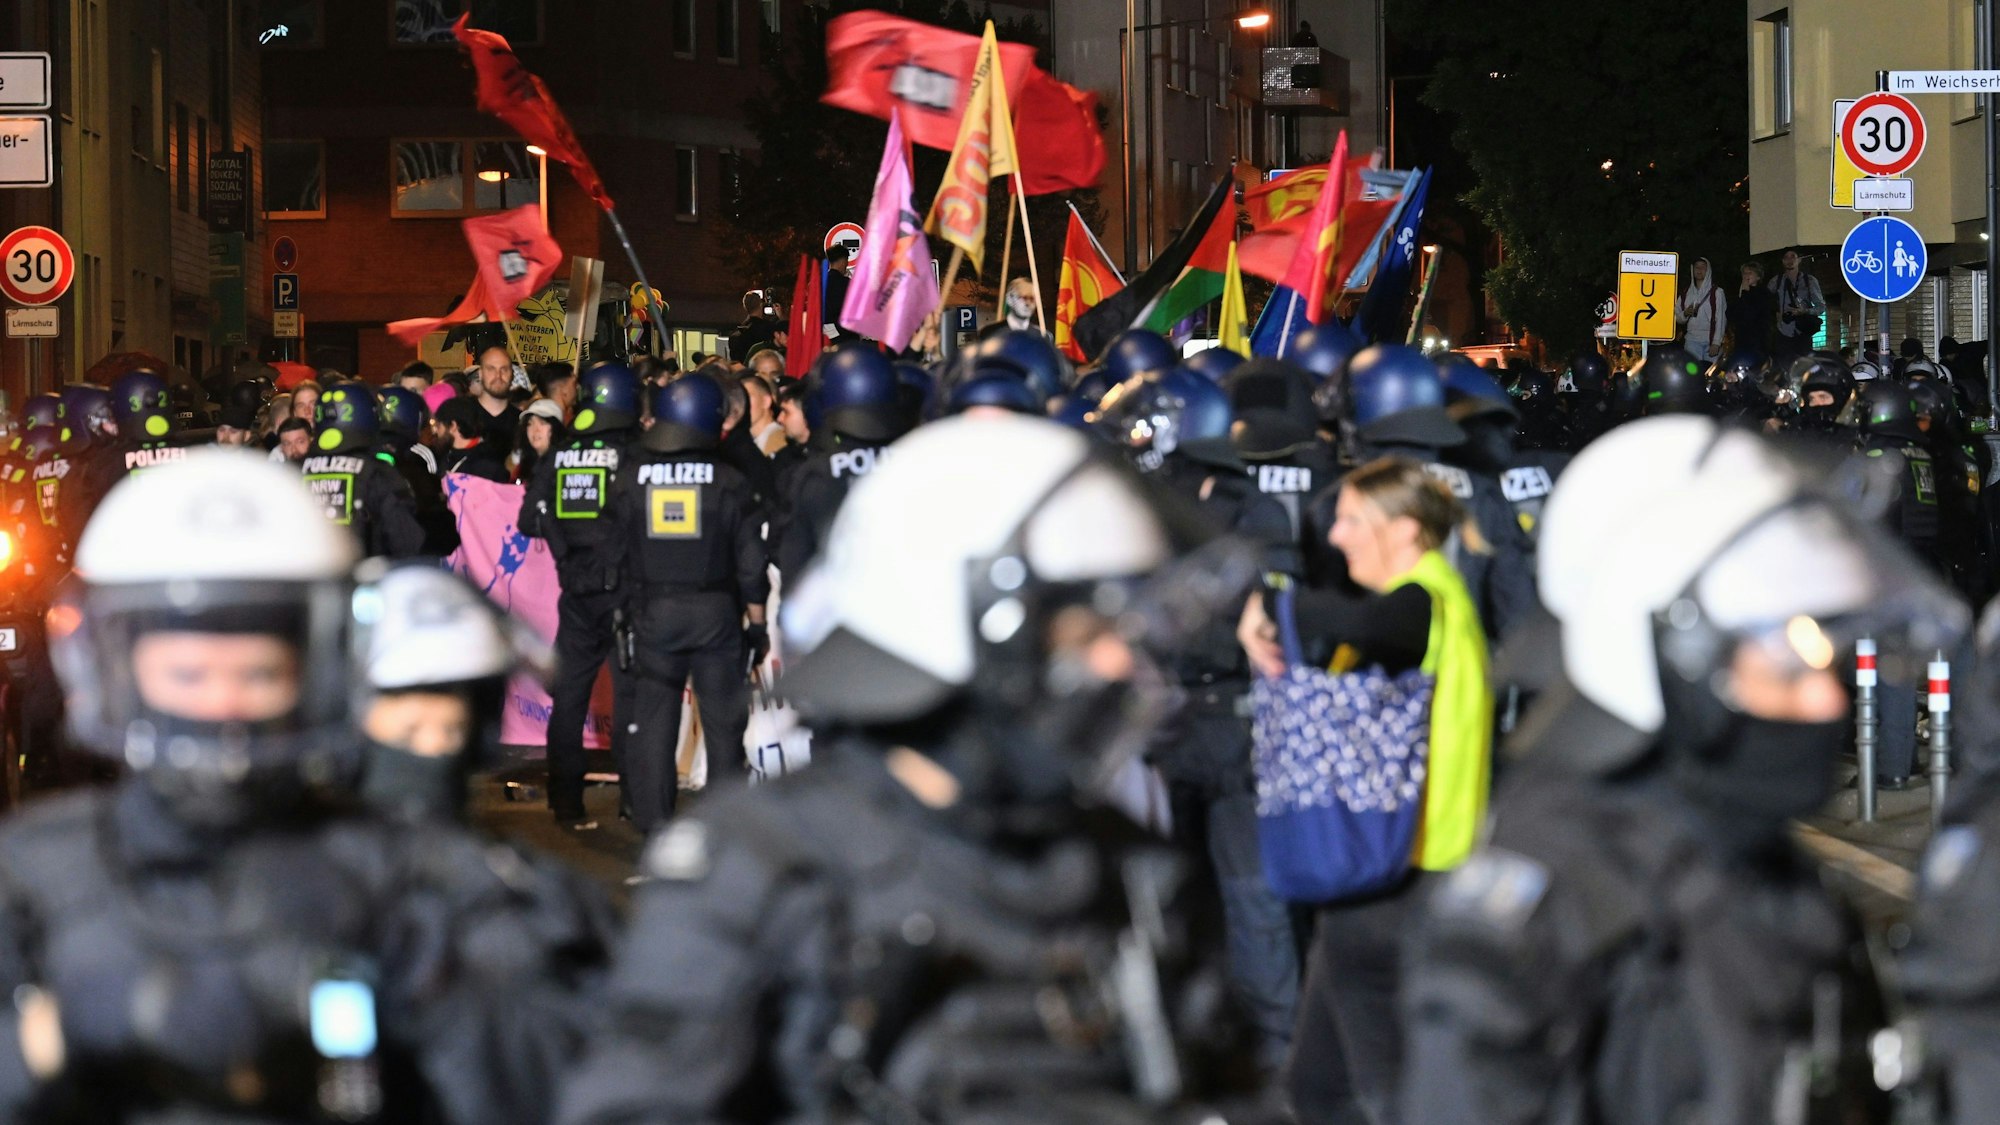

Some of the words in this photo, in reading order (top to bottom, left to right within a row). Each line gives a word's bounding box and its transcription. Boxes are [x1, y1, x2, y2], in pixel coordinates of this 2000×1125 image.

[1897, 76, 1914, 89] Im
[0, 134, 29, 148] er-
[1860, 117, 1906, 153] 30
[1860, 191, 1906, 199] Lärmschutz
[12, 249, 55, 283] 30
[279, 278, 293, 305] P
[1641, 279, 1655, 298] U
[12, 320, 53, 328] Lärmschutz
[960, 308, 973, 328] P
[341, 403, 354, 422] 2
[302, 456, 364, 474] POLIZEI
[637, 463, 714, 485] POLIZEI
